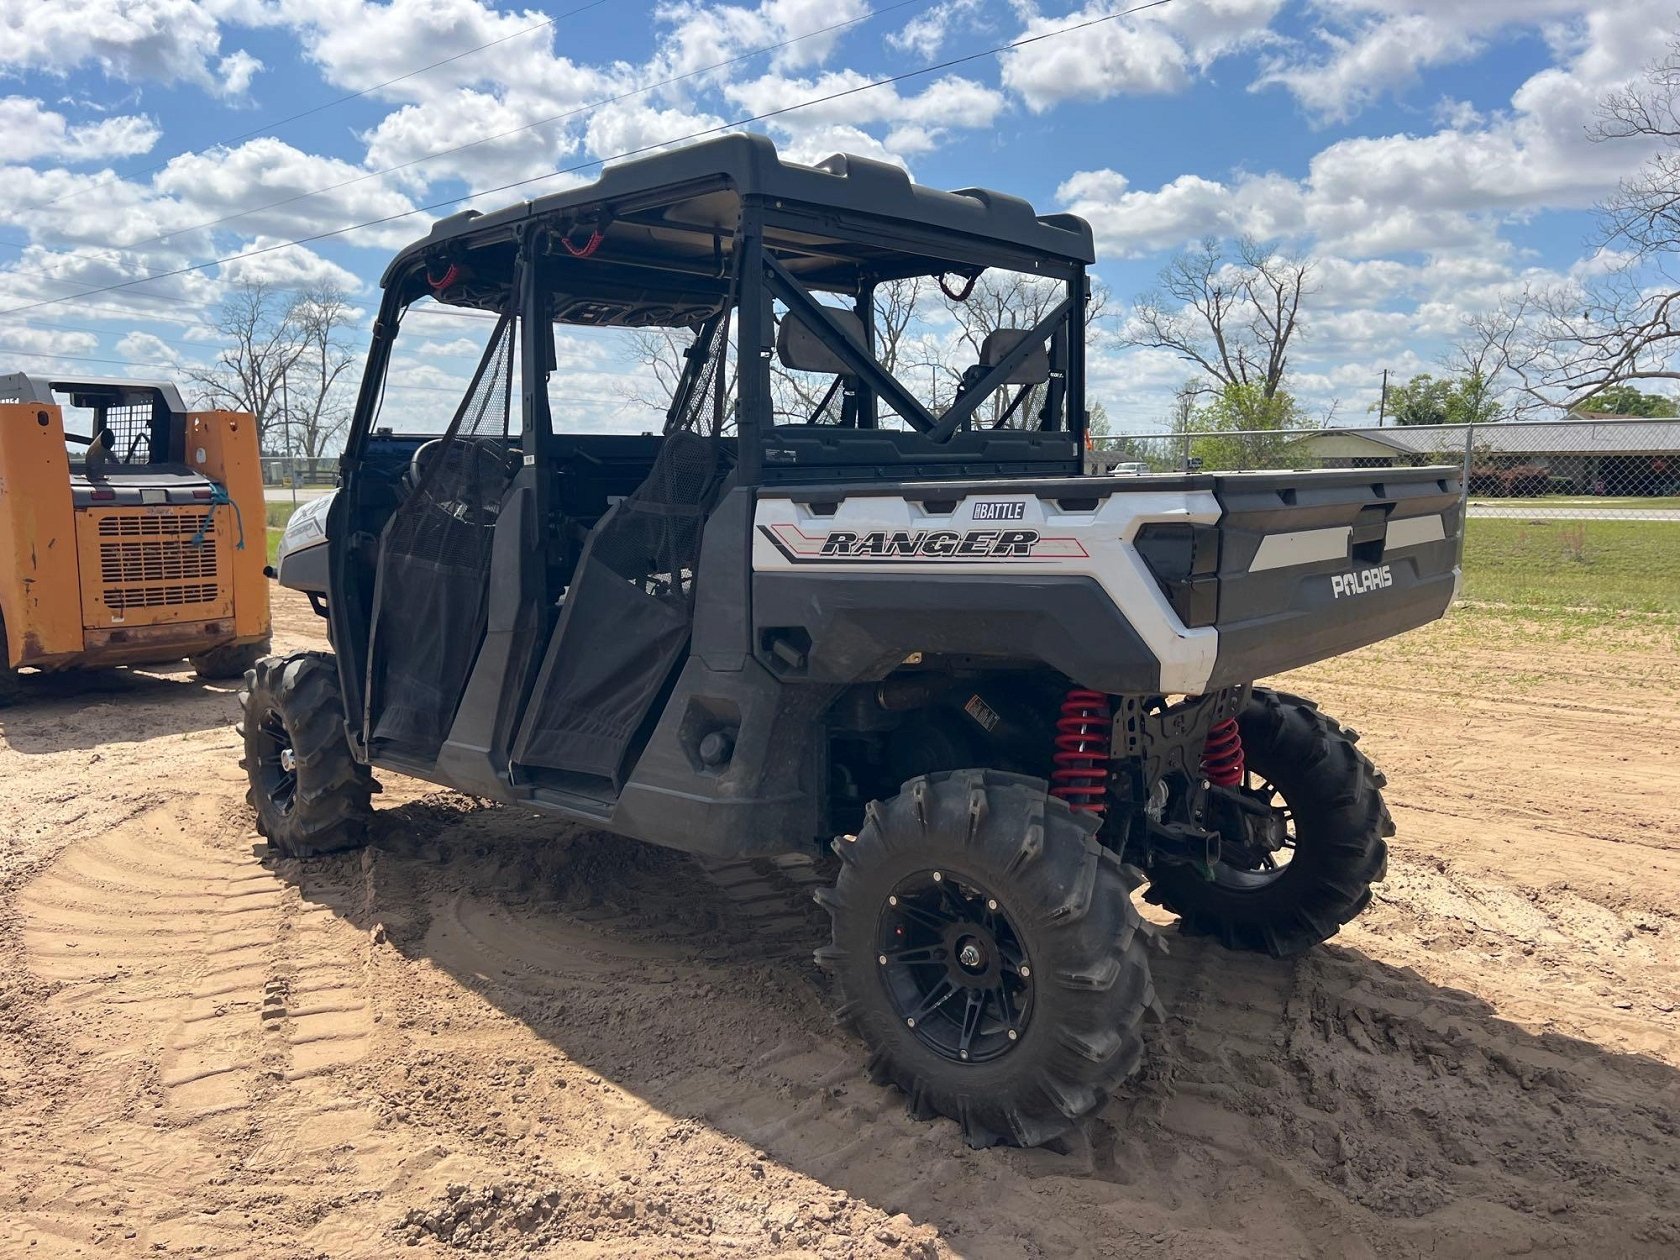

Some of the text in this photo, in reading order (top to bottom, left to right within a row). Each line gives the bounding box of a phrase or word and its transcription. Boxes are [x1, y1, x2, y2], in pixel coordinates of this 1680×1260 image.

[980, 503, 1023, 519] BATTLE
[819, 529, 1041, 557] RANGER
[1331, 565, 1393, 599] POLARIS
